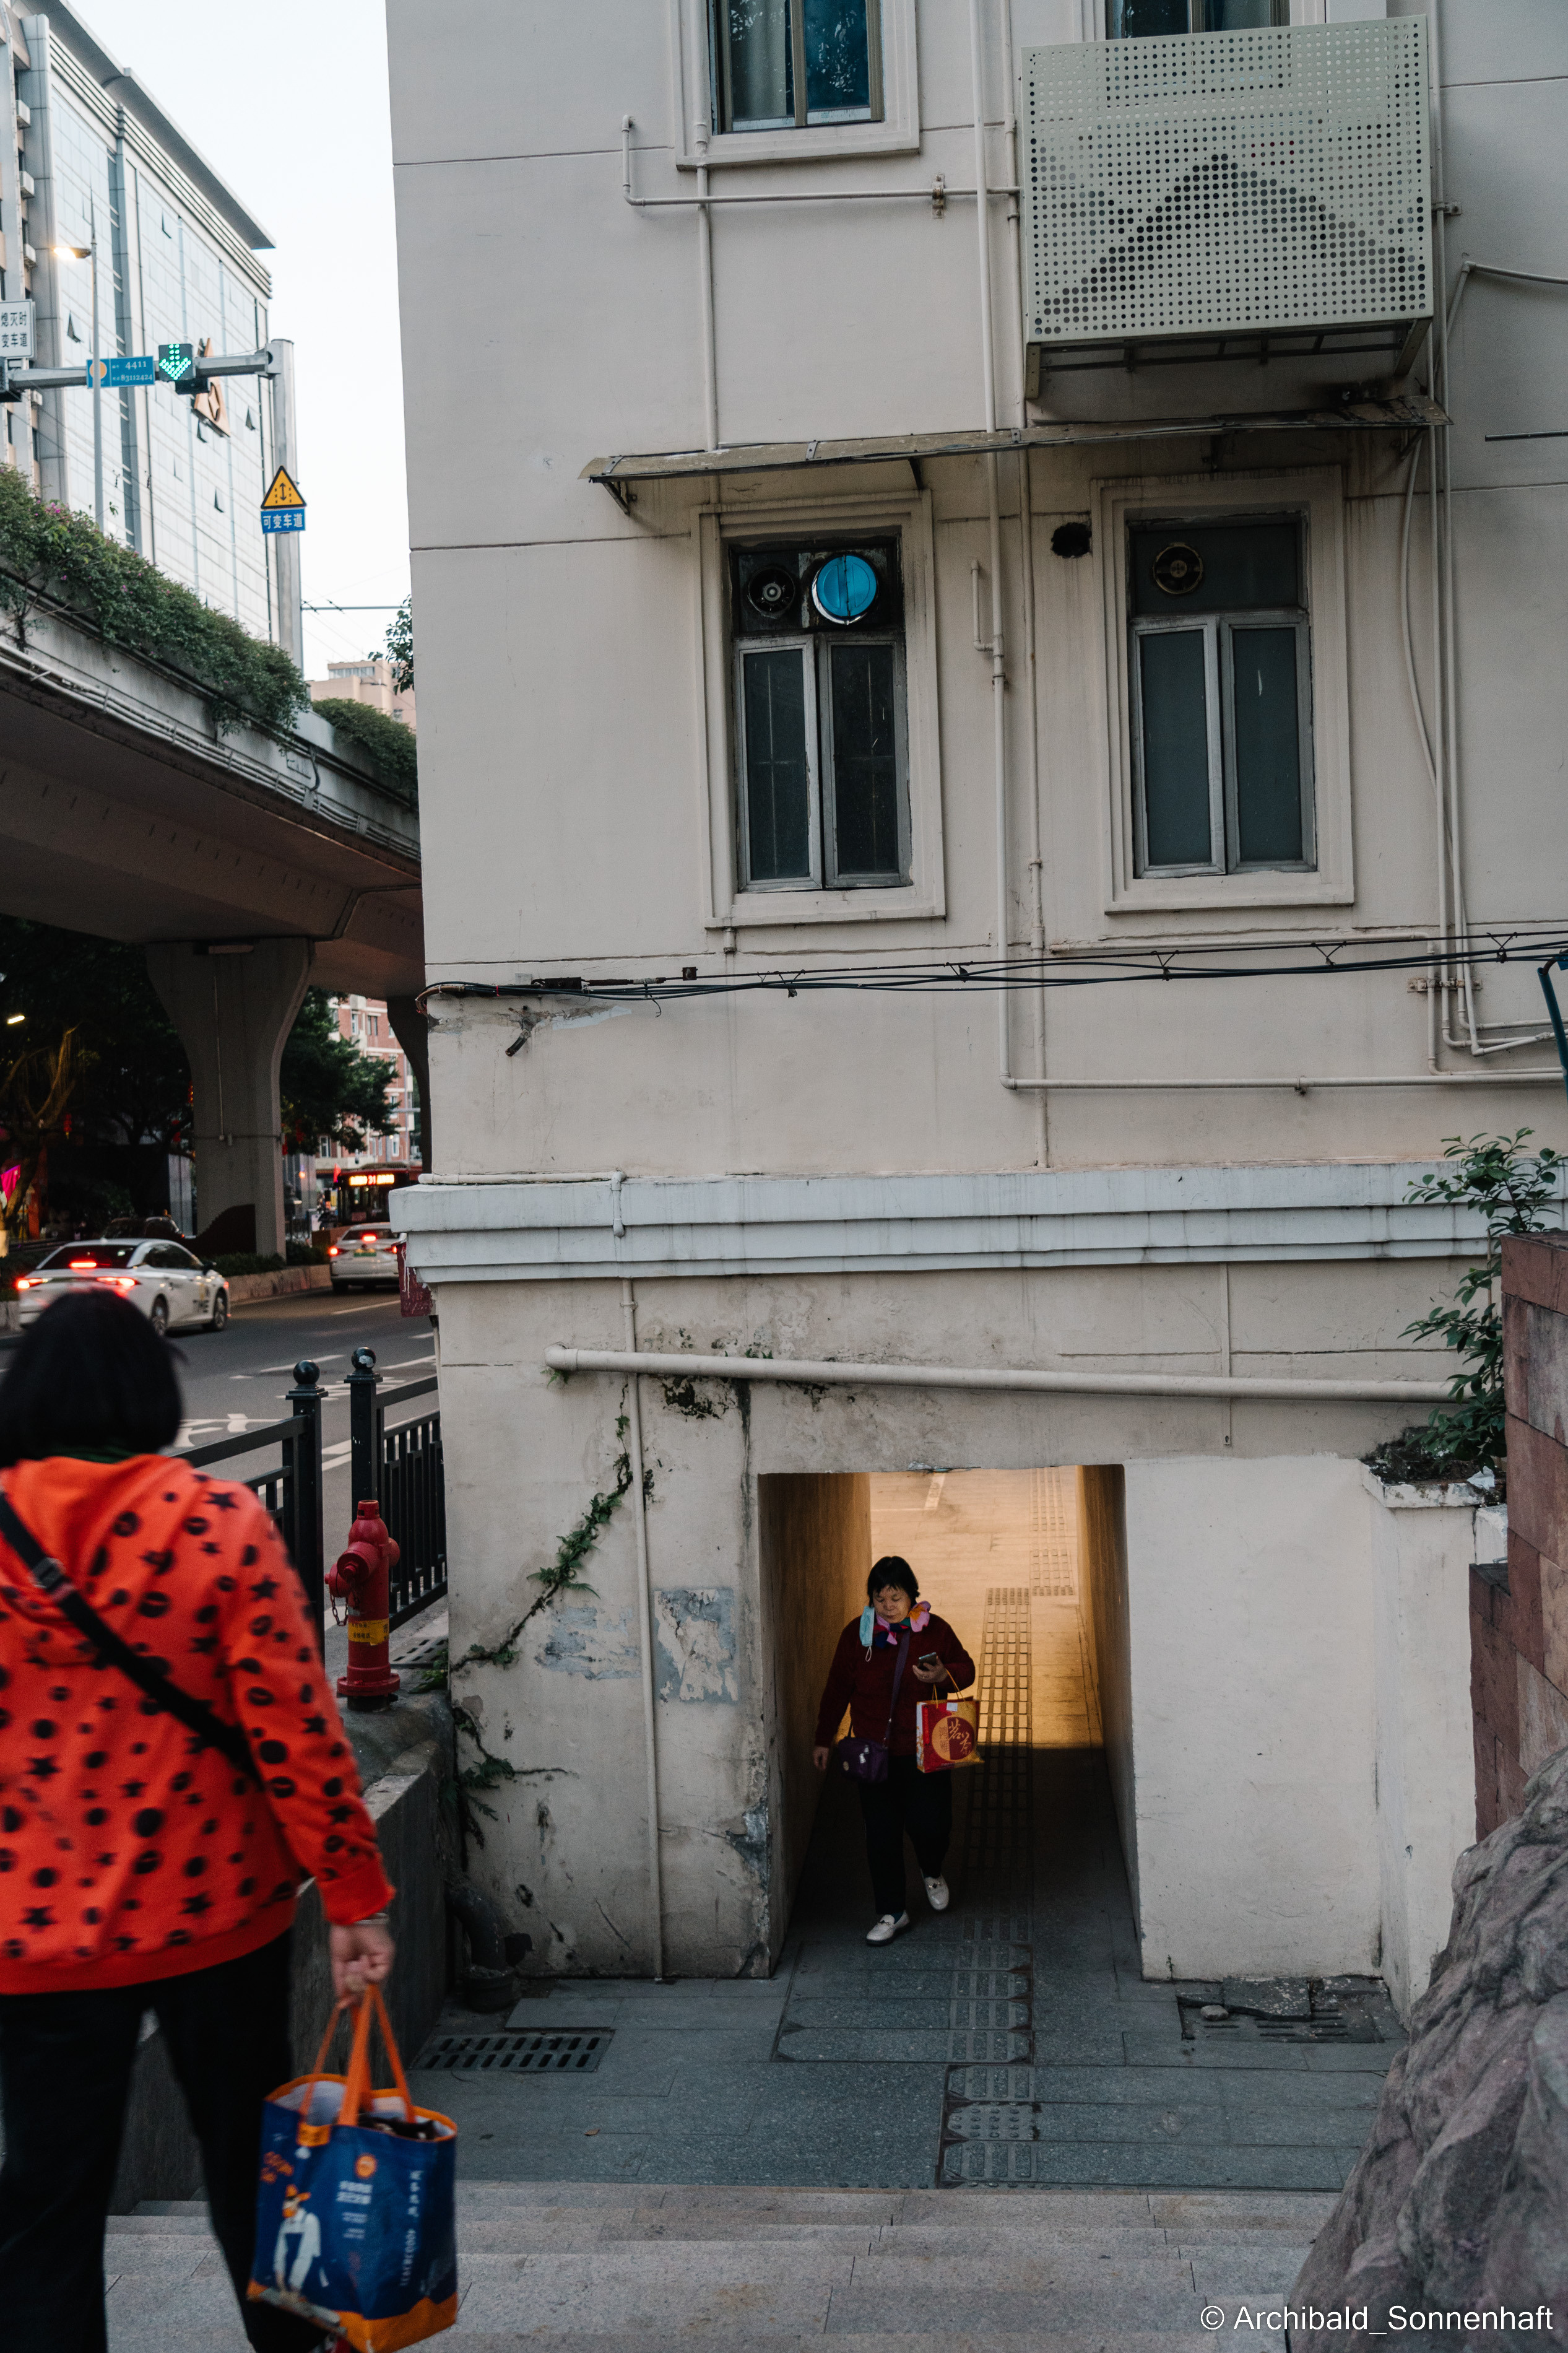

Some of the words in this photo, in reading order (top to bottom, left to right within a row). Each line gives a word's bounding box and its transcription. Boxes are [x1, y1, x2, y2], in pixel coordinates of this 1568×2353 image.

[2, 333, 27, 347] 变车道
[125, 361, 147, 370] 4411
[121, 374, 153, 382] 83112424
[262, 513, 303, 529] 可变车道
